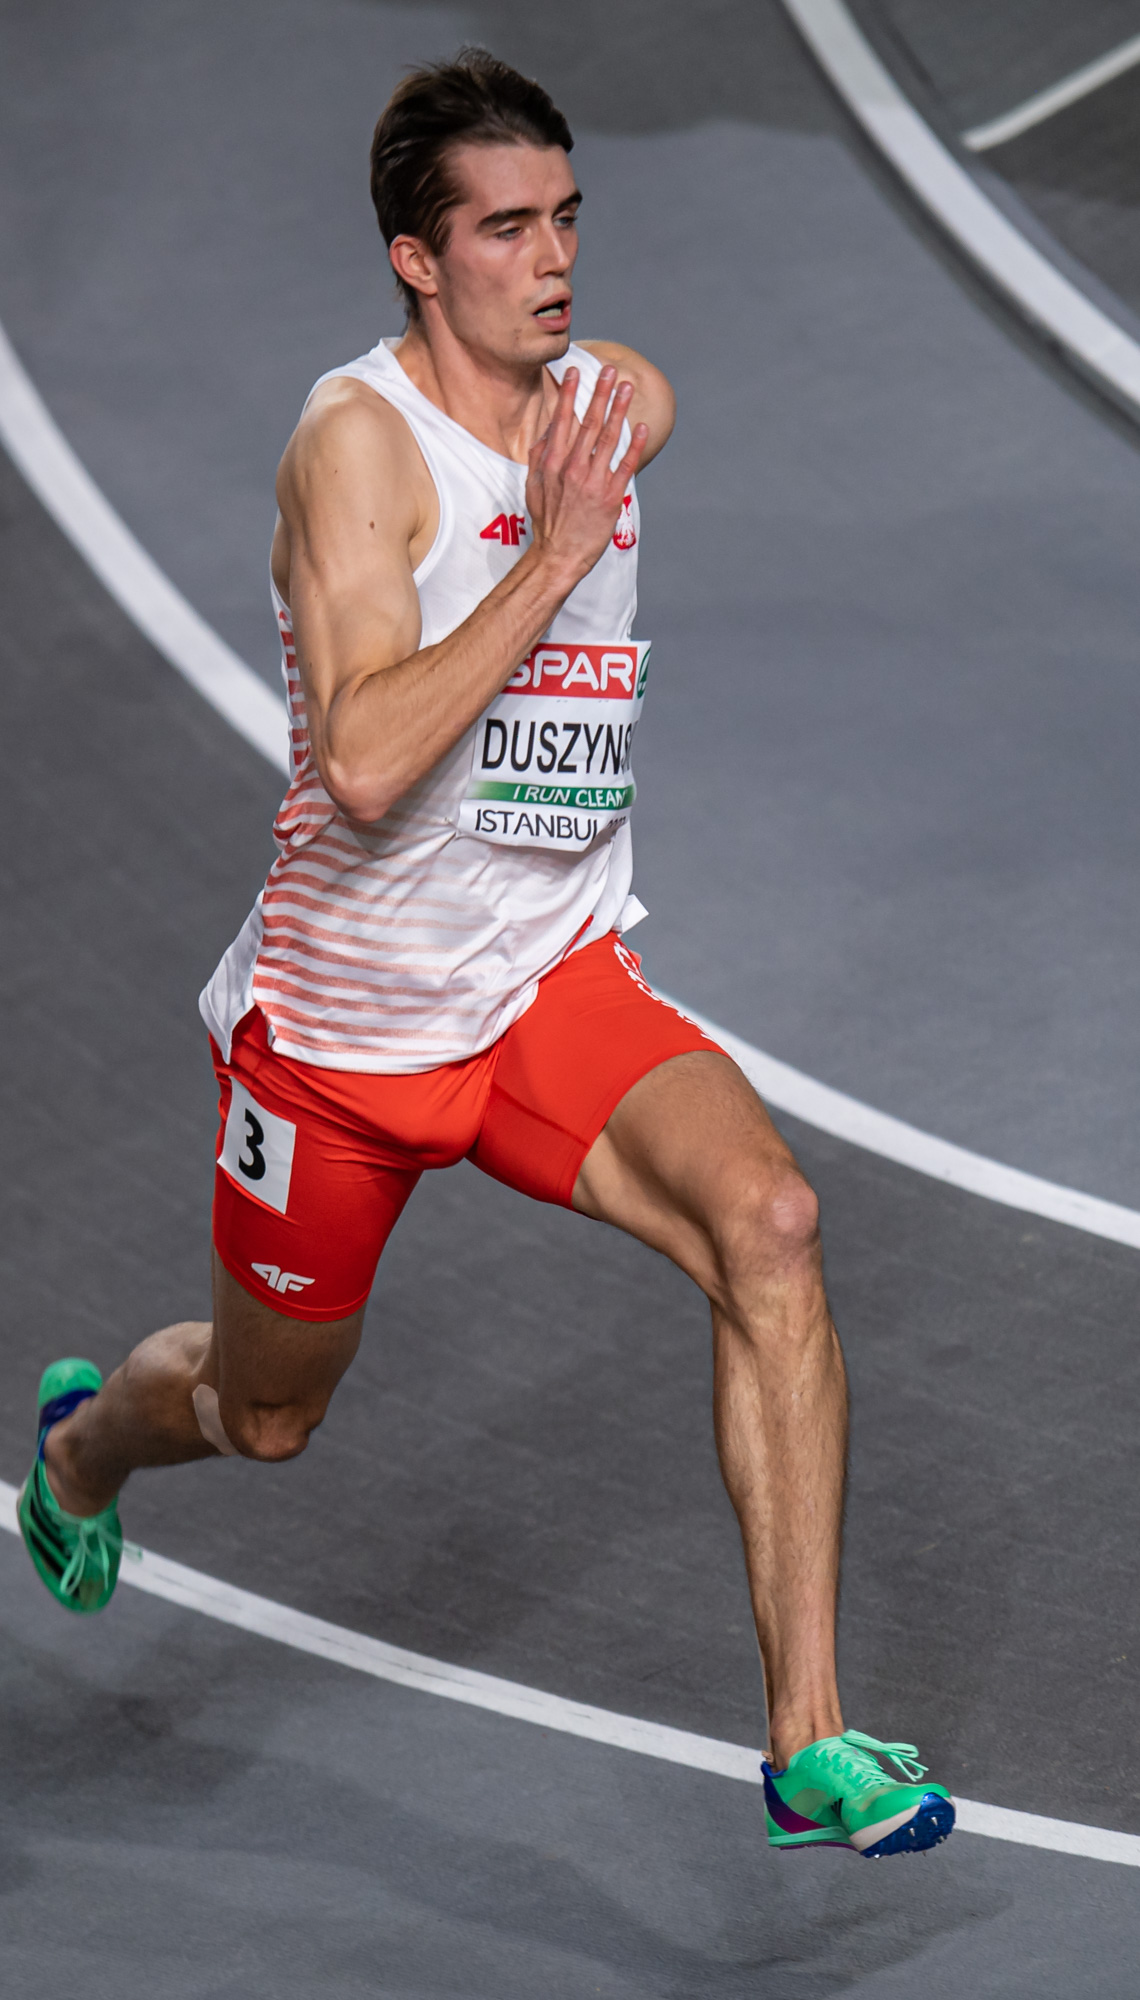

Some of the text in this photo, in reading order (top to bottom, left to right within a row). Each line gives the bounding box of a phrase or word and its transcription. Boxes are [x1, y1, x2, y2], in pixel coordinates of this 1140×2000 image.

[513, 785, 626, 808] I RUN CLEAN
[238, 1107, 267, 1181] 3
